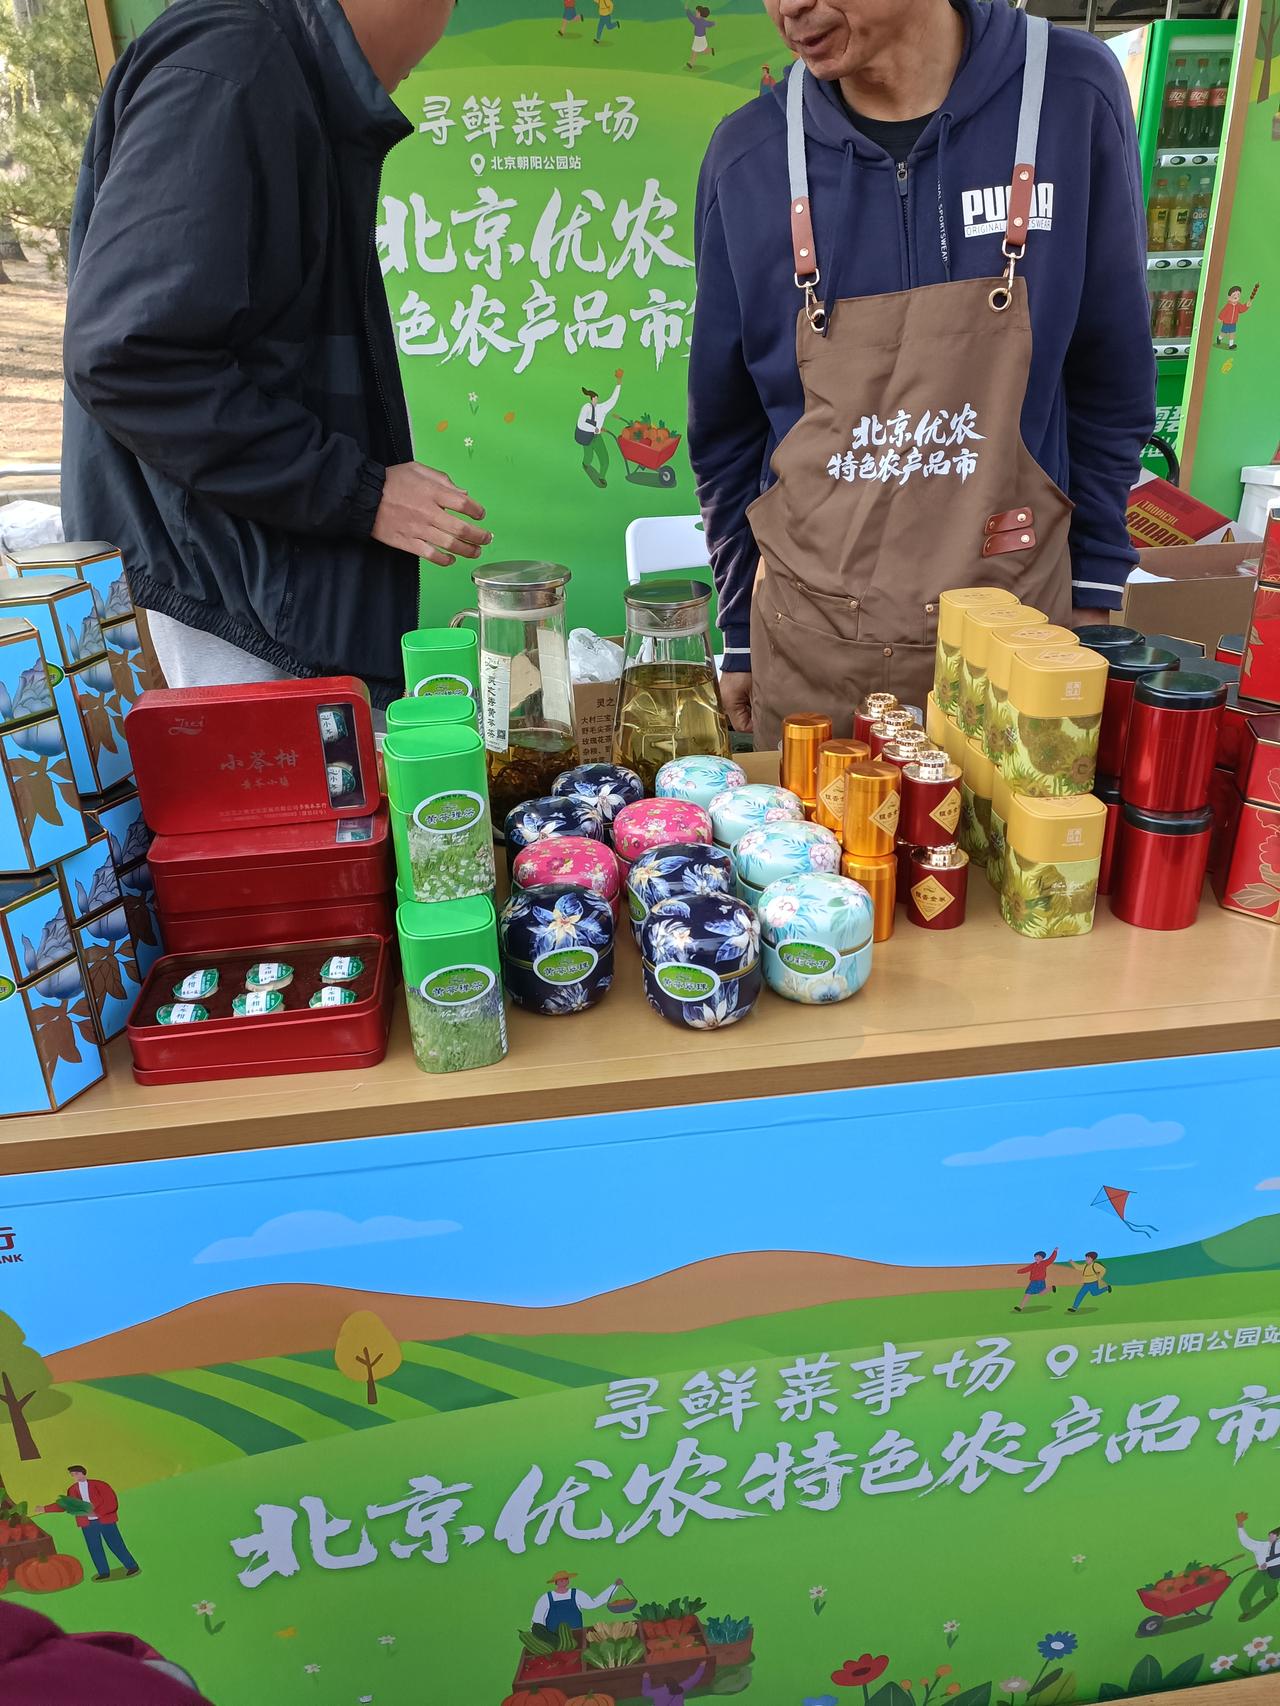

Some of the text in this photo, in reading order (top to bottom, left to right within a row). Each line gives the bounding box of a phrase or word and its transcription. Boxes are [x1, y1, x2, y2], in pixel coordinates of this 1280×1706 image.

[419, 88, 640, 149] 寻鲜菜事场
[491, 155, 581, 170] 北京朝阳公园站
[375, 178, 695, 280] 北京优农
[396, 279, 697, 374] 色农产品市
[852, 402, 987, 450] 北京优农
[826, 447, 979, 485] 特色农产品市
[0, 1254, 24, 1264] NK
[1090, 1325, 1280, 1365] 北京朝阳公园站
[595, 1337, 1016, 1440] 寻鲜菜事场
[230, 1385, 1280, 1589] 北京优农特色农产品市
